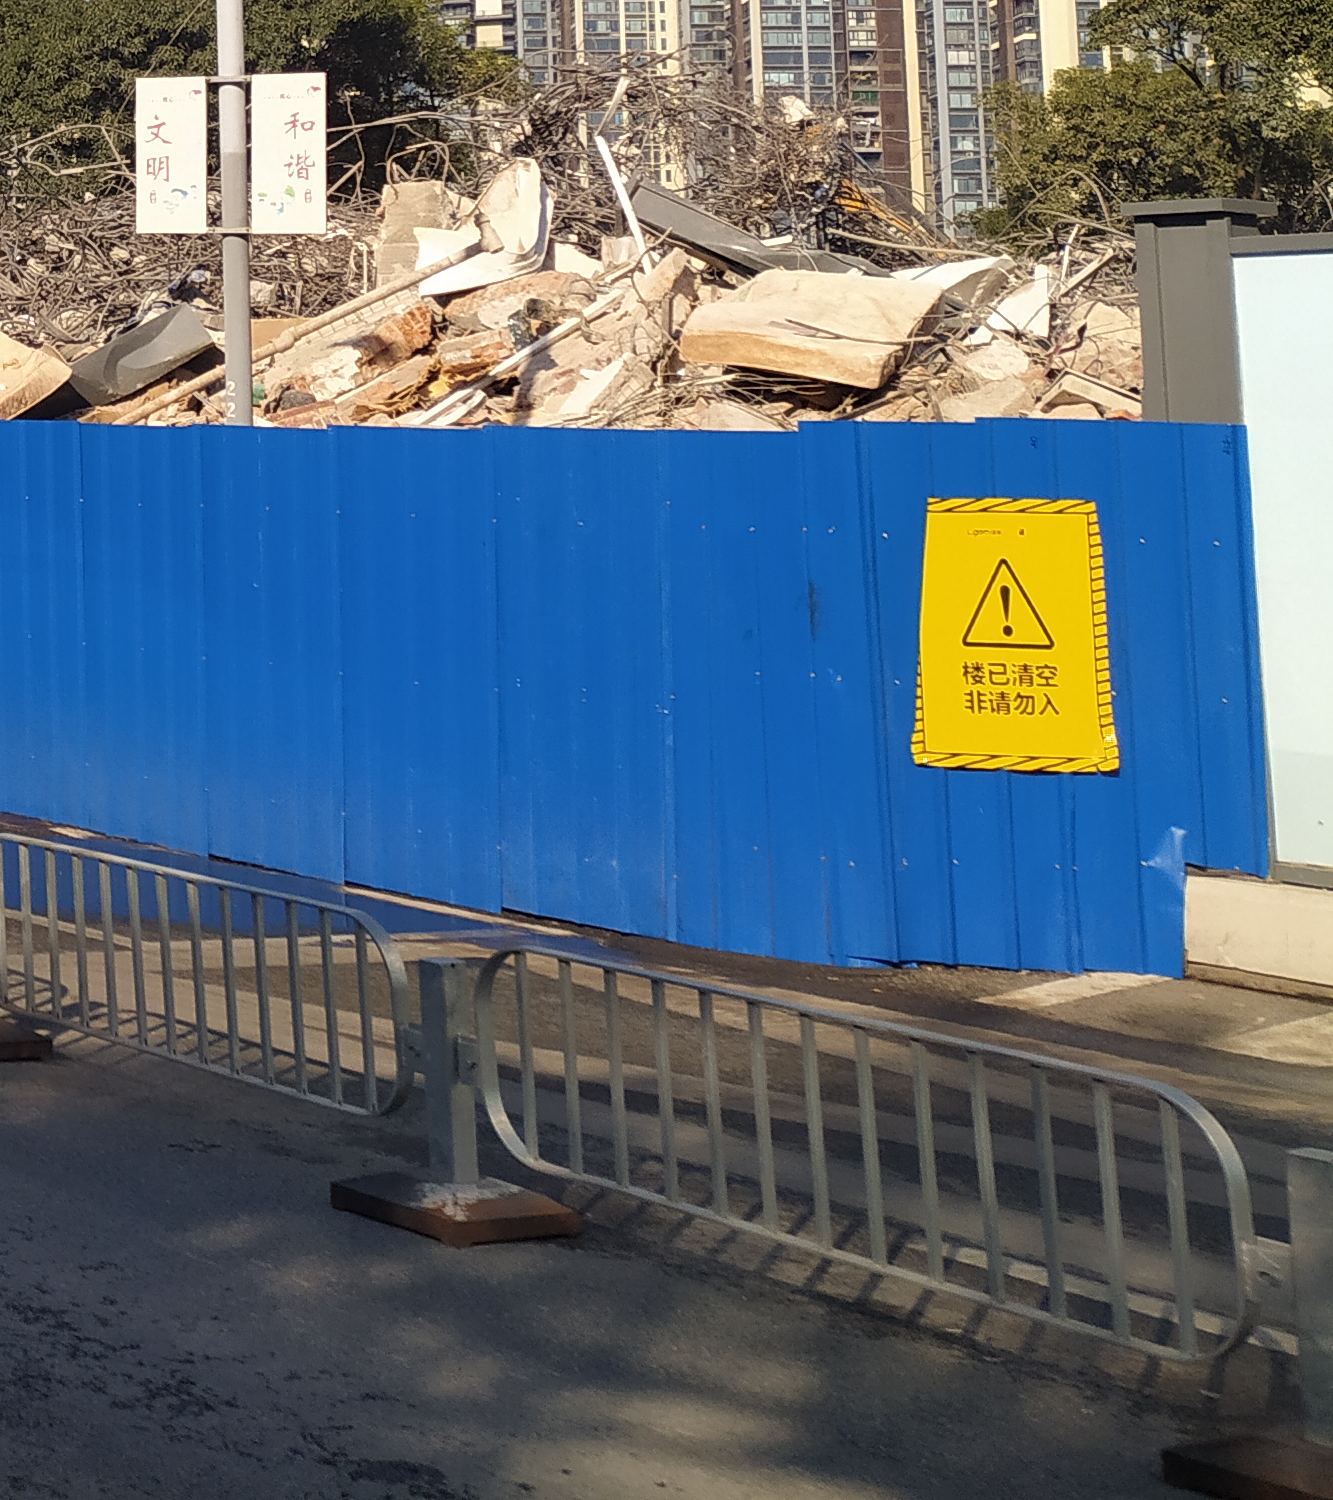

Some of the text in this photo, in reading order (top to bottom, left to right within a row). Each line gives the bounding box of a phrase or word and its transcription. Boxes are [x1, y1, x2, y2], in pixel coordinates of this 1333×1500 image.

[144, 114, 173, 182] 文明
[284, 112, 316, 181] 和谐
[961, 661, 1060, 687] 楼已清空
[963, 689, 1061, 716] 非请勿入
